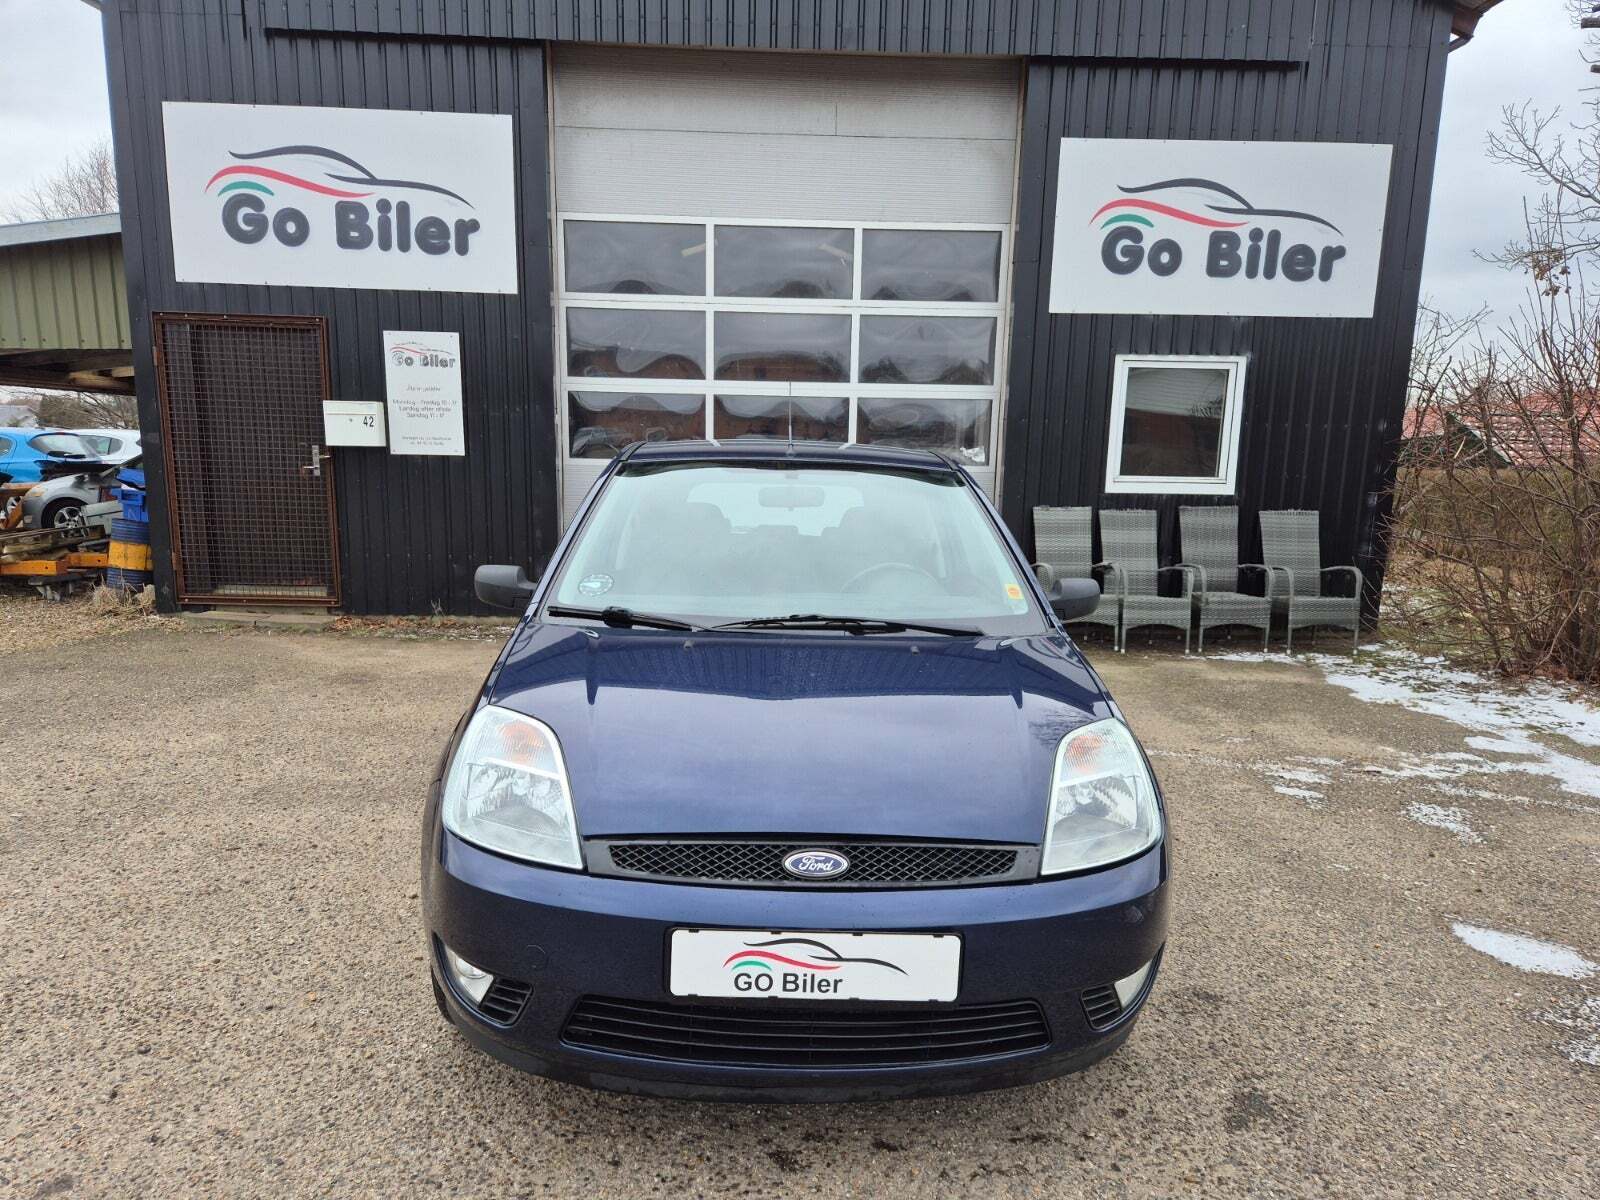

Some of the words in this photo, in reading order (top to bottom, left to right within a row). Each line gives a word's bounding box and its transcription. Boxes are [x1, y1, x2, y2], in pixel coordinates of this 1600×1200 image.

[222, 193, 310, 247] Go
[335, 198, 481, 256] Biler
[1101, 225, 1182, 277] Go
[1205, 227, 1347, 282] Biler
[392, 352, 414, 366] Go
[420, 354, 456, 368] Biler
[363, 415, 375, 428] 42
[798, 856, 834, 872] Ford
[733, 972, 774, 992] GO
[782, 973, 843, 993] Biler
